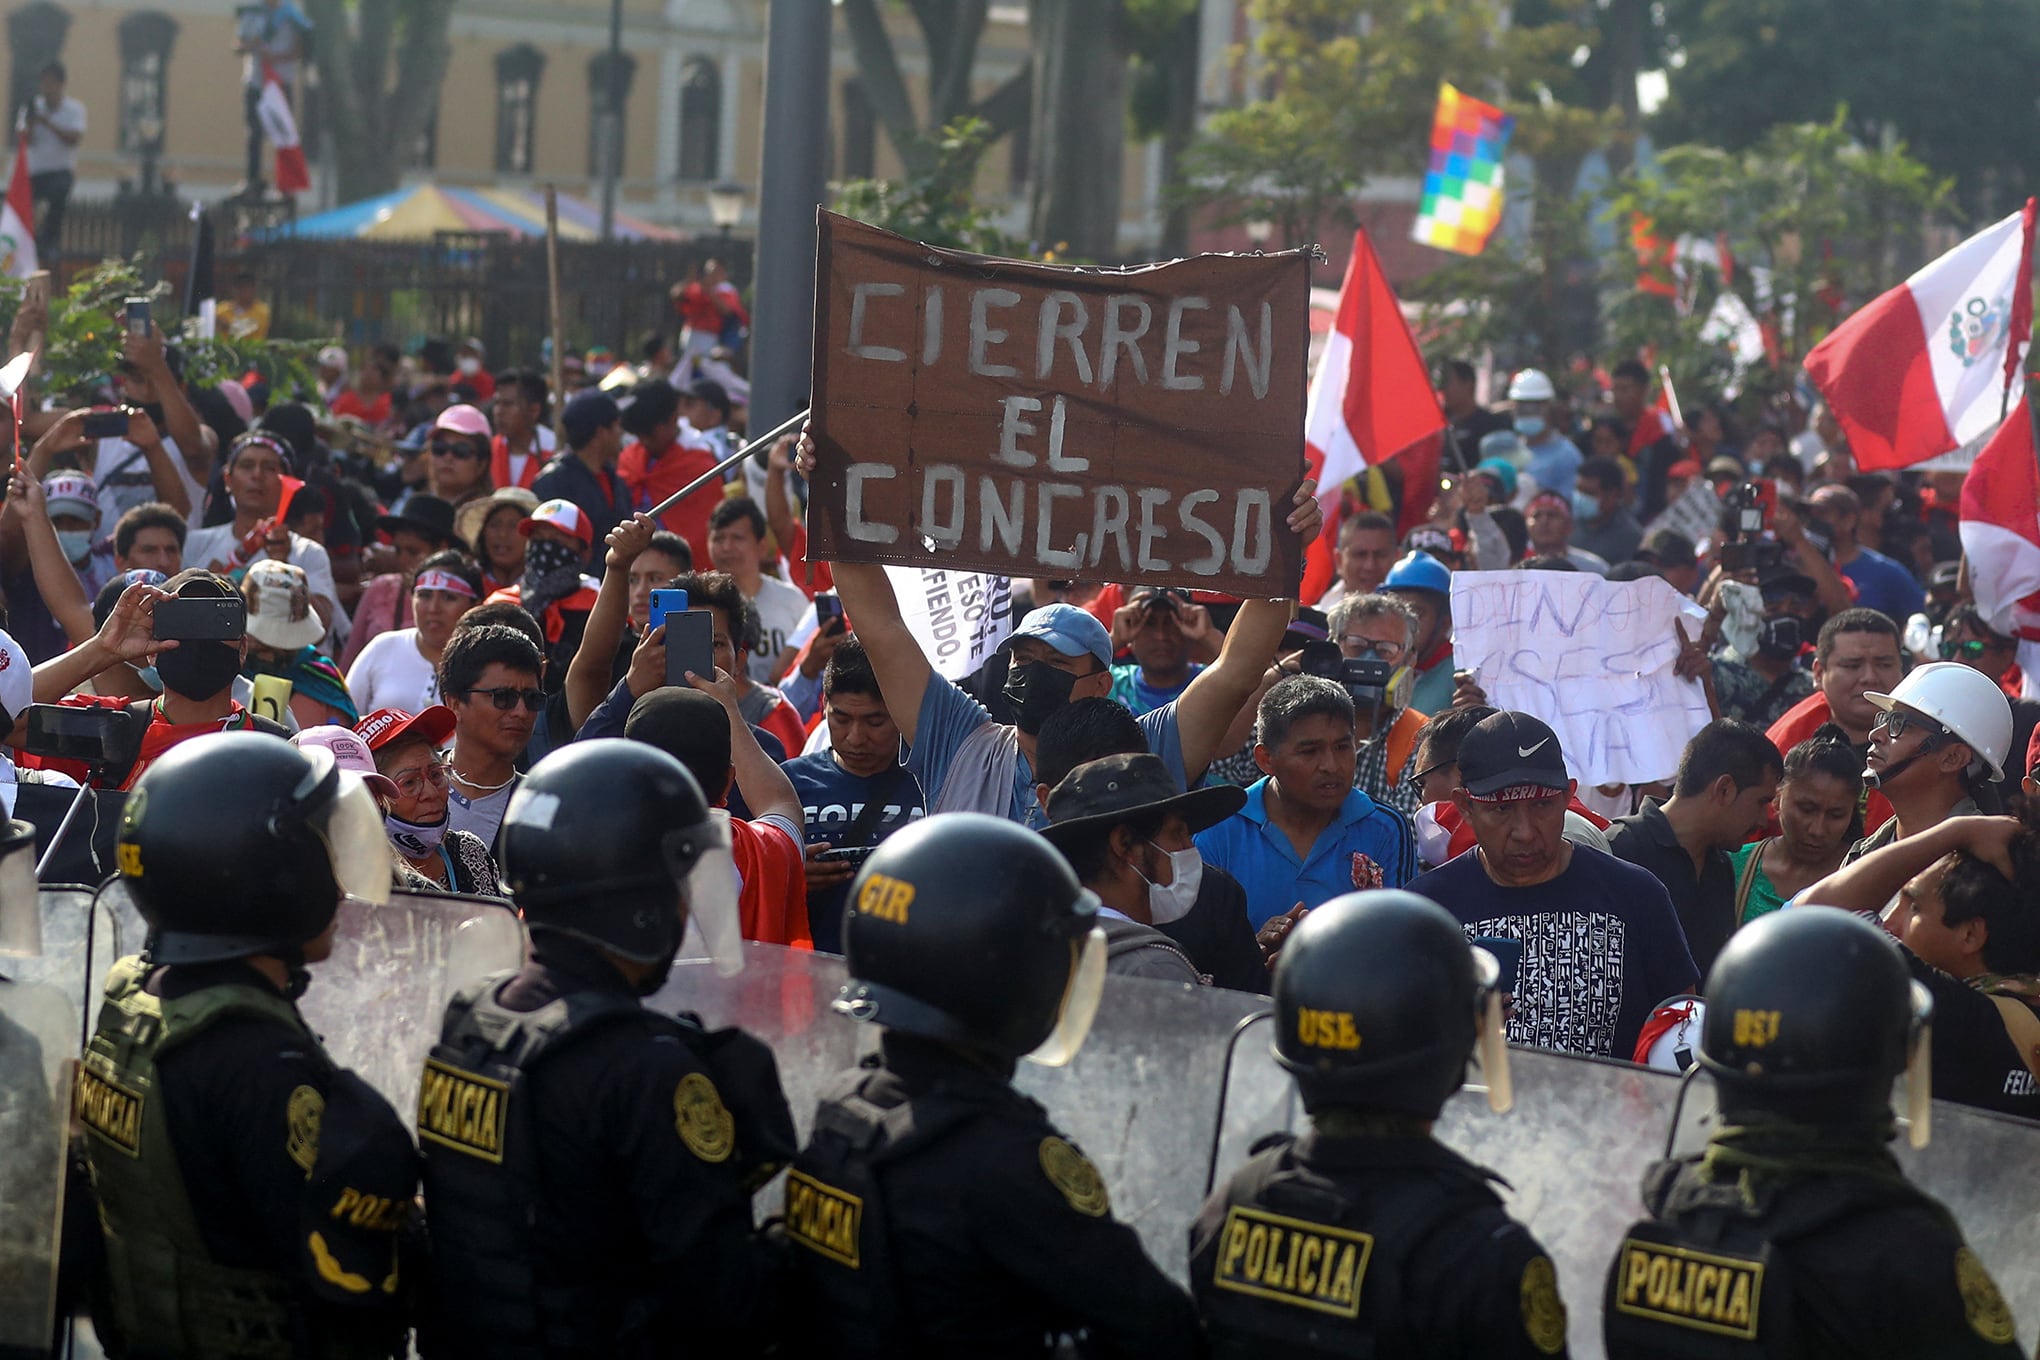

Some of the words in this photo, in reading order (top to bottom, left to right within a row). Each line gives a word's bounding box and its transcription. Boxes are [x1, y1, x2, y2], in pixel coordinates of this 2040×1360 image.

[843, 283, 1272, 400] CIERREN
[990, 394, 1090, 473] EL
[845, 463, 1271, 576] CONGRESO
[957, 574, 986, 623] ESO
[969, 625, 985, 660] TE
[858, 872, 916, 926] GIR
[1298, 1006, 1361, 1050] USE
[80, 1072, 138, 1147] POLICIA
[422, 1068, 499, 1151] POLICIA
[788, 1181, 853, 1254] POLICIA
[1223, 1219, 1356, 1302] POLICIA
[1626, 1250, 1750, 1326] POLICIA
